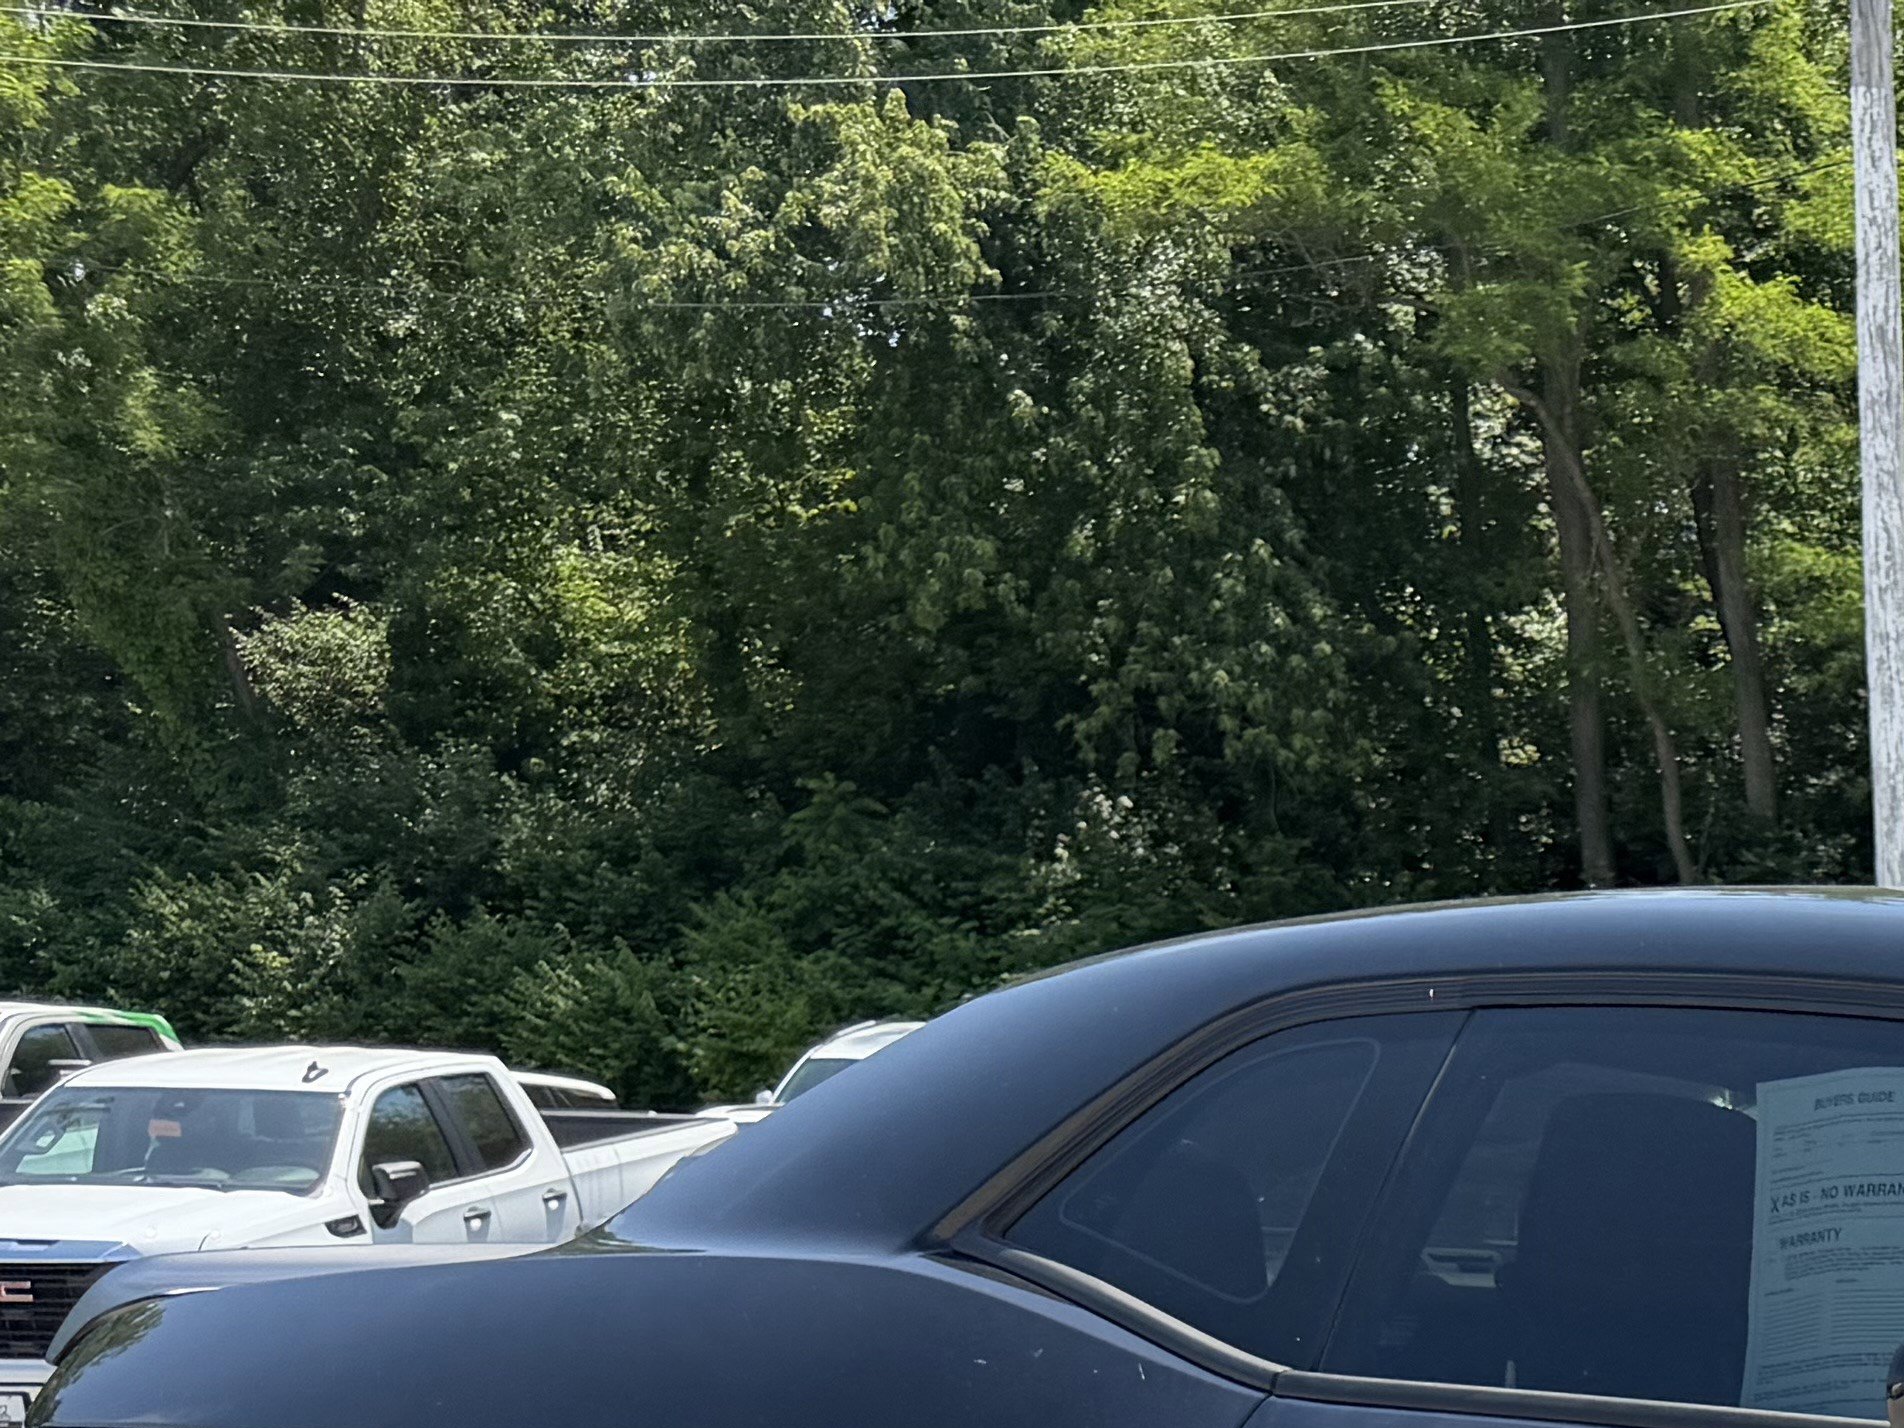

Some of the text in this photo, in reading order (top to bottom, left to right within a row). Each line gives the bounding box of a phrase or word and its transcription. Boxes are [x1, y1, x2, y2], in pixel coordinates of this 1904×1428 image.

[1857, 1091, 1896, 1104] GUIDE
[1781, 1193, 1796, 1207] AS
[1799, 1190, 1811, 1203] IS
[1820, 1185, 1839, 1199] NO
[1779, 1227, 1842, 1249] WARRANTY
